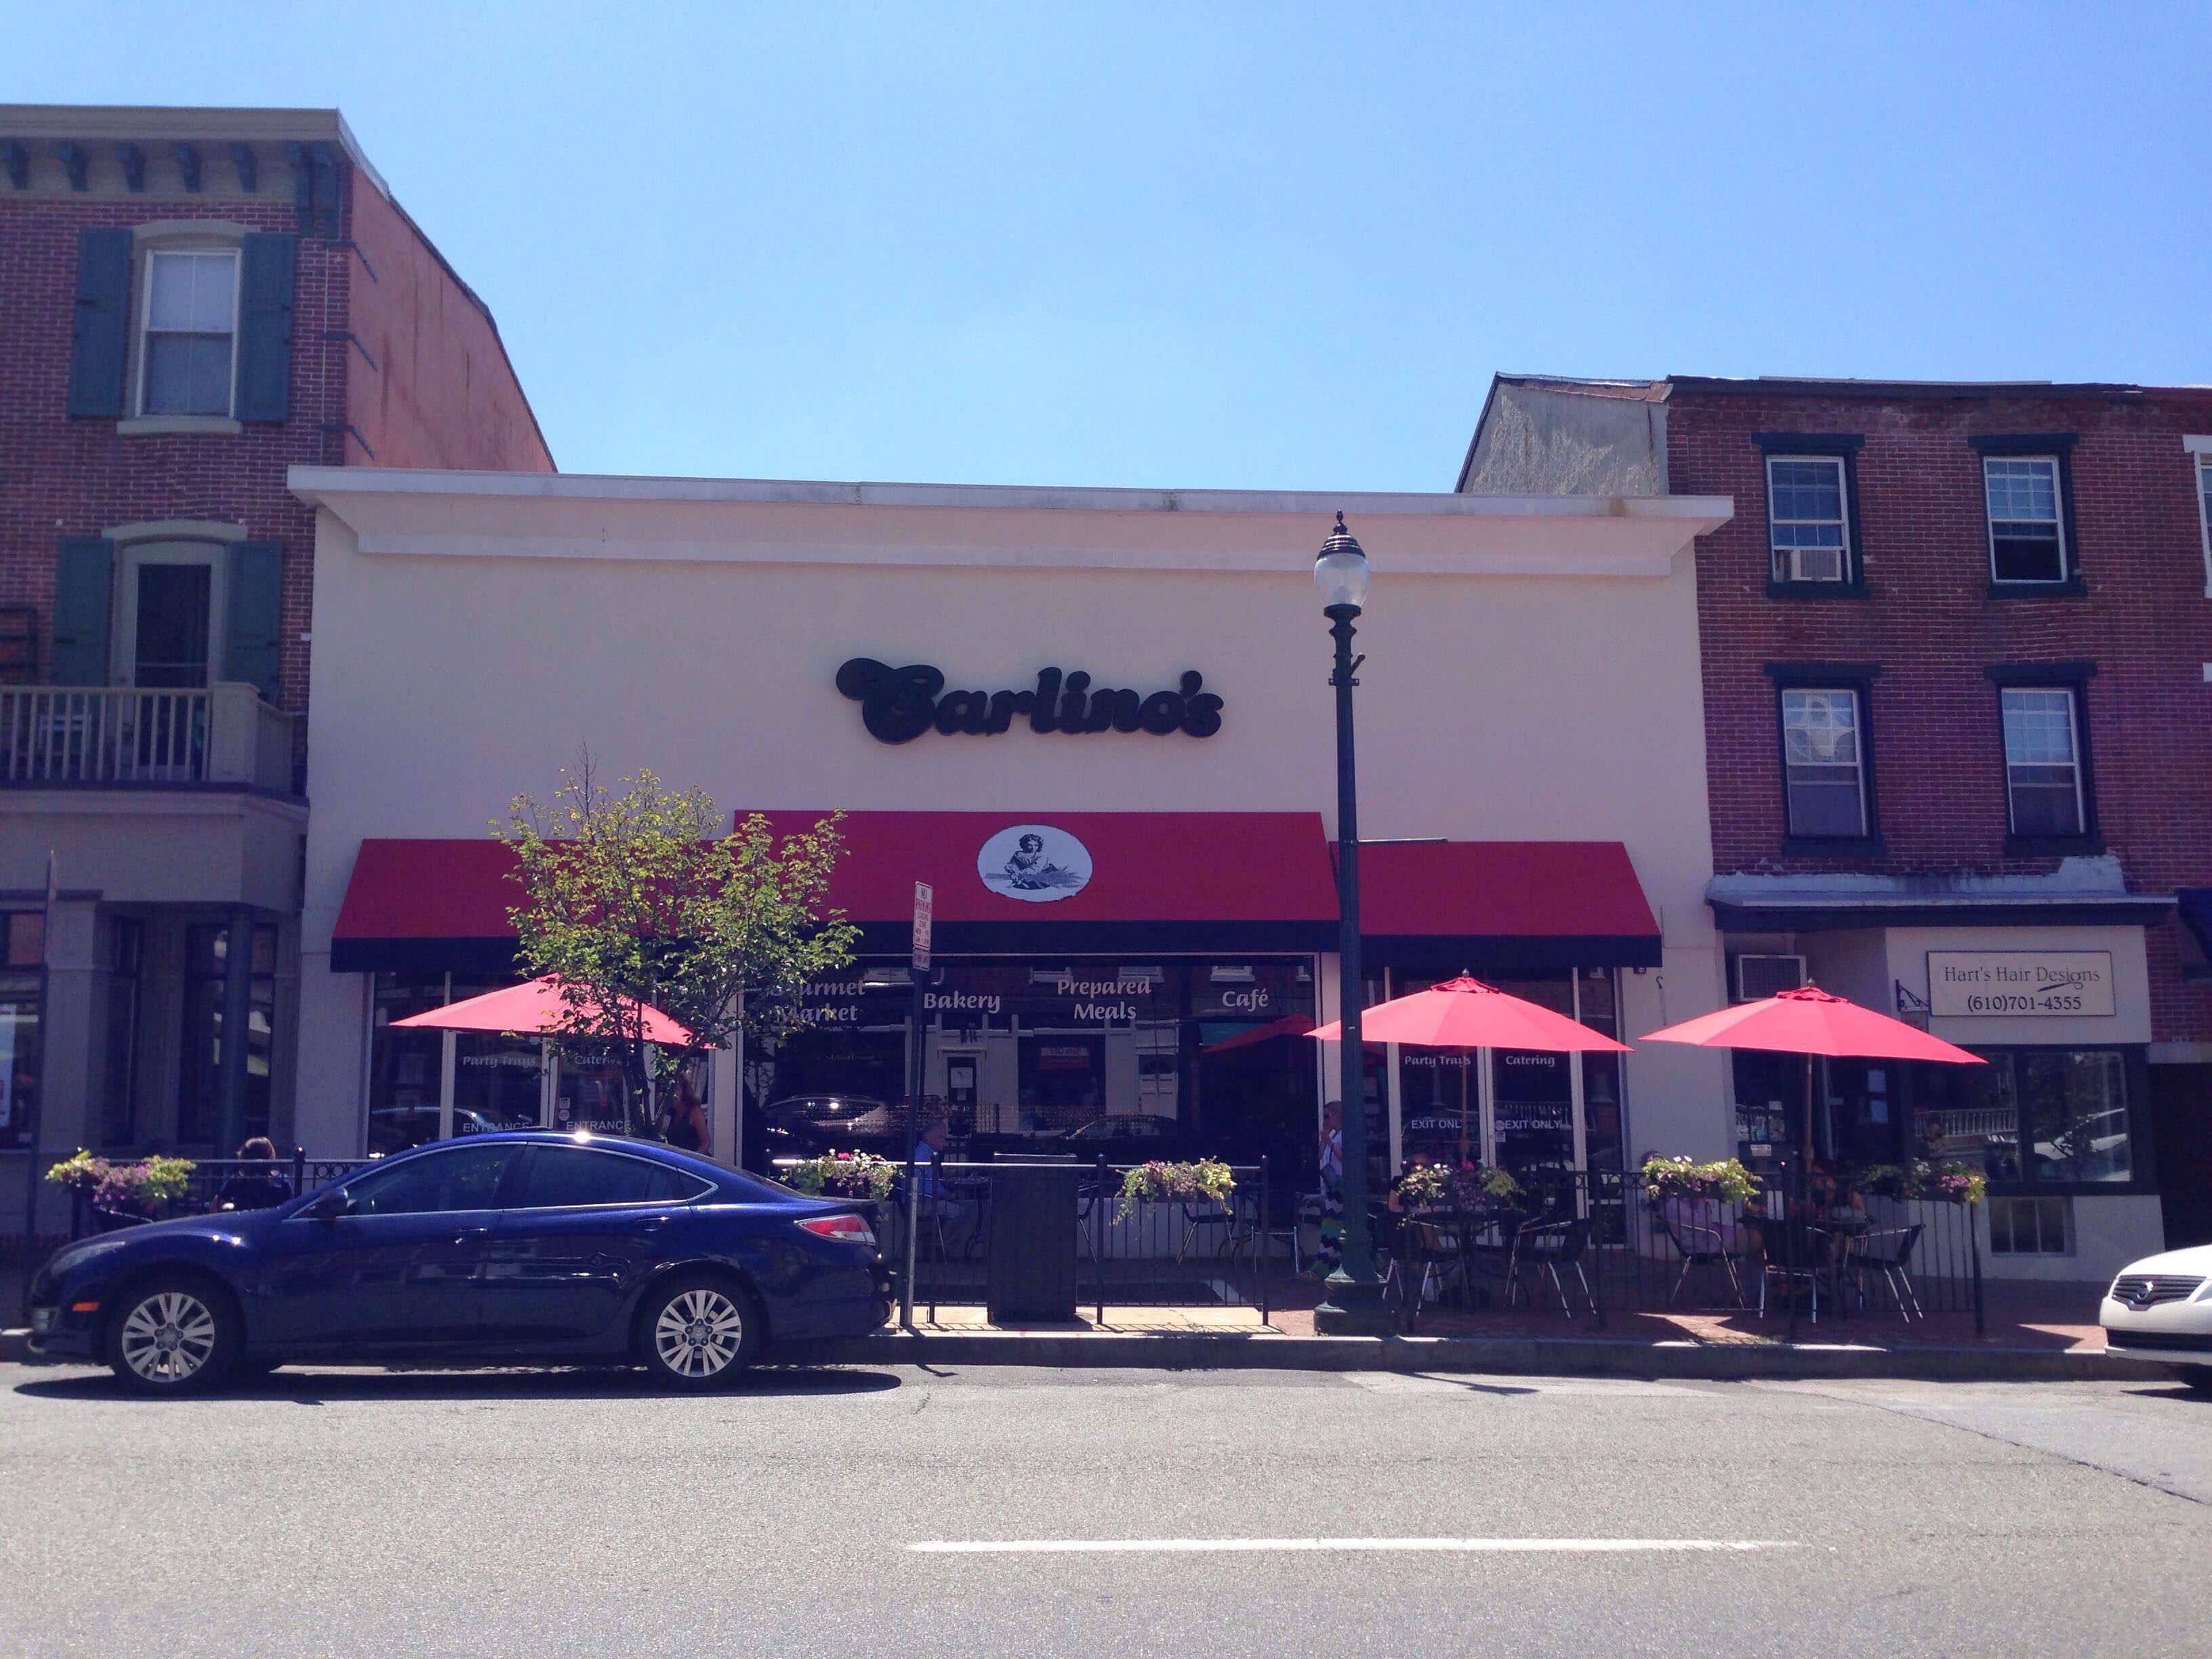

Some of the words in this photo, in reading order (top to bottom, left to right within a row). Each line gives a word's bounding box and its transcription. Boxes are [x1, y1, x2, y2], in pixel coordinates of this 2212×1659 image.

[836, 657, 1224, 745] Carlino's
[1945, 966, 1991, 982] Hart's
[1996, 967, 2031, 982] Hair
[2036, 966, 2100, 989] Designs
[767, 979, 865, 996] urmet
[1057, 975, 1151, 998] Prepared
[924, 990, 1000, 1014] Bakery
[1222, 987, 1268, 1012] Café
[1967, 994, 2082, 1011] (610)701-4355
[1073, 1001, 1137, 1020] Meals
[462, 1055, 497, 1068] Party
[501, 1055, 536, 1068] Trays
[1404, 1055, 1436, 1067] Party
[1506, 1055, 1555, 1067] Catering
[566, 1120, 632, 1131] ENTRANCE
[1411, 1120, 1435, 1130] EXIT
[1439, 1119, 1464, 1130] ONL
[1504, 1120, 1528, 1130] EXIT
[1532, 1119, 1561, 1130] ONLY
